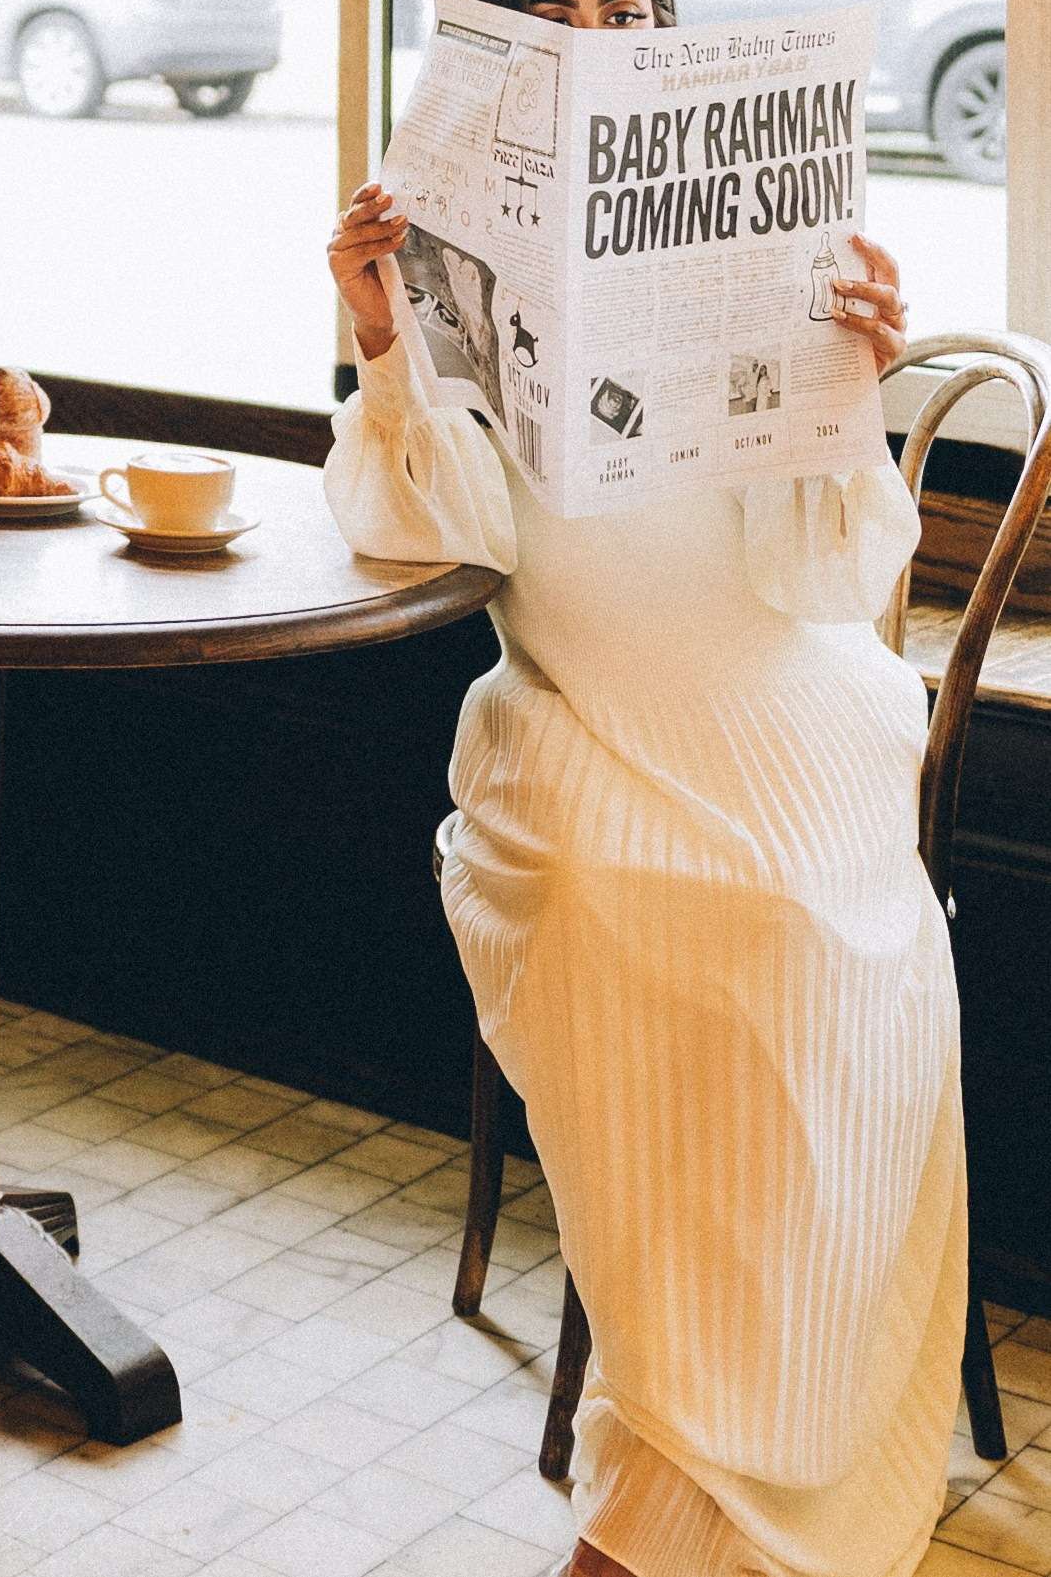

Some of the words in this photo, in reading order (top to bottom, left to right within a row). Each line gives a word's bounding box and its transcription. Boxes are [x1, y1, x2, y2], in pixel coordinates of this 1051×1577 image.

[634, 46, 674, 71] The
[680, 42, 721, 67] New
[727, 36, 776, 62] Baby
[781, 29, 836, 53] Times
[588, 106, 698, 185] BABY
[703, 79, 856, 170] RAHMAN
[492, 148, 520, 169] FREE
[524, 158, 556, 179] GAZA
[584, 172, 741, 260] COMING
[750, 151, 853, 235] SOON!
[507, 362, 551, 409] OCT/NOV
[734, 433, 773, 450] OCT/NOV
[816, 423, 840, 438] 2024
[606, 456, 629, 472] BABY
[669, 447, 701, 464] COMING
[598, 469, 636, 485] RAHMAN
